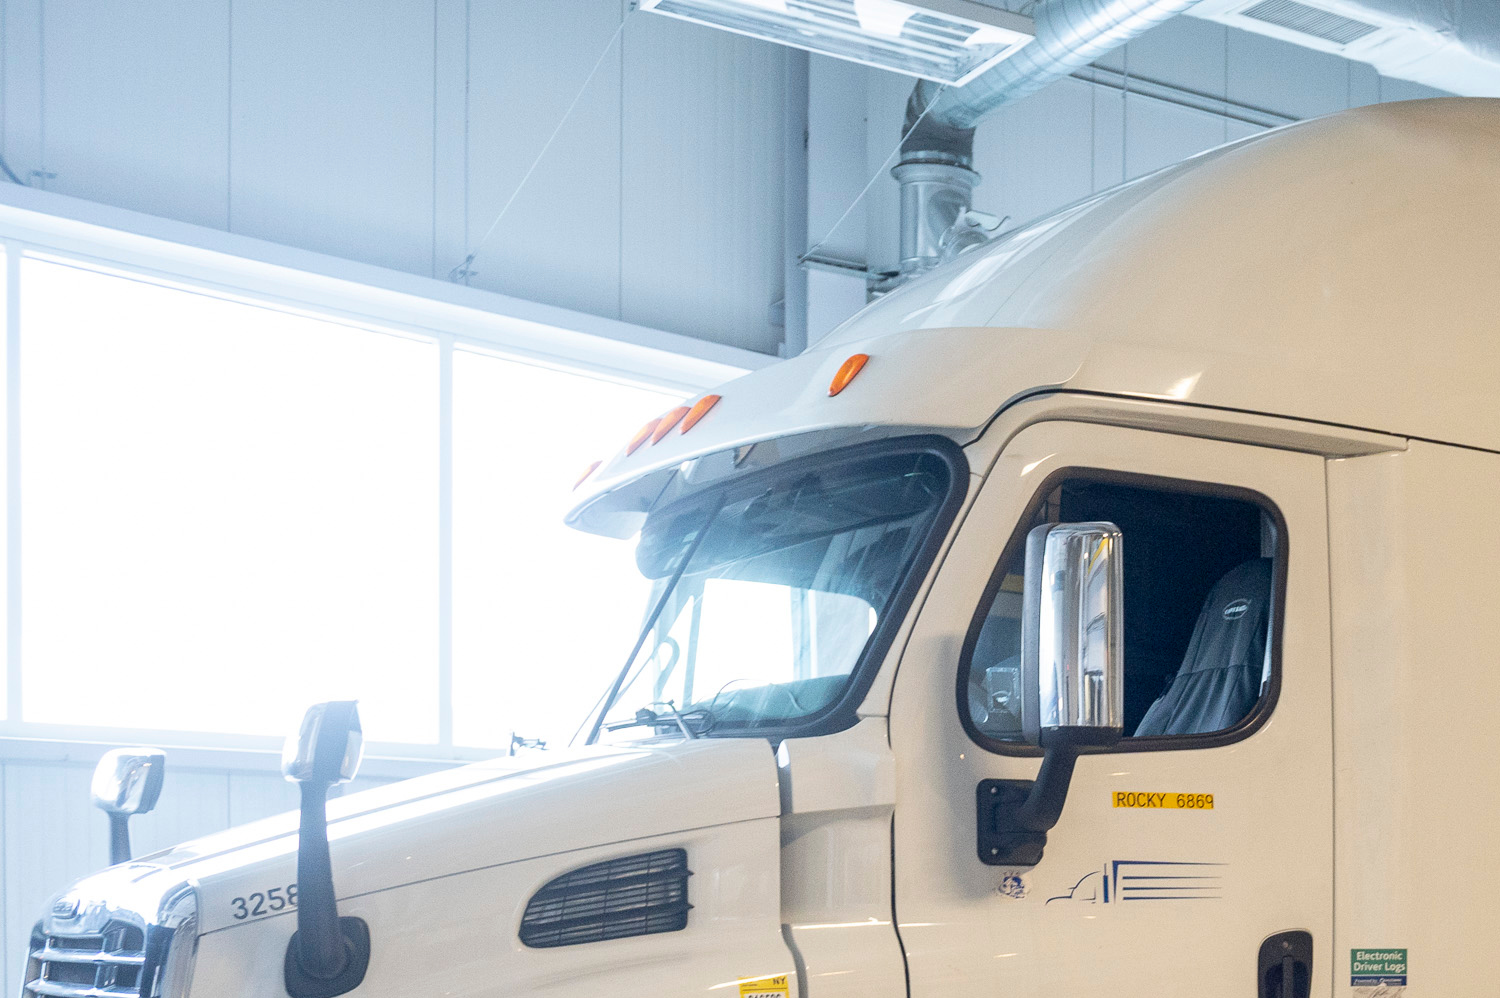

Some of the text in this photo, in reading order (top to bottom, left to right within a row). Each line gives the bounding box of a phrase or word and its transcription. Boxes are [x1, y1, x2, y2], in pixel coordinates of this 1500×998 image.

[1116, 792, 1214, 809] ROCKY 6869
[1356, 951, 1403, 961] Electronic
[1353, 962, 1405, 973] Driver Logs
